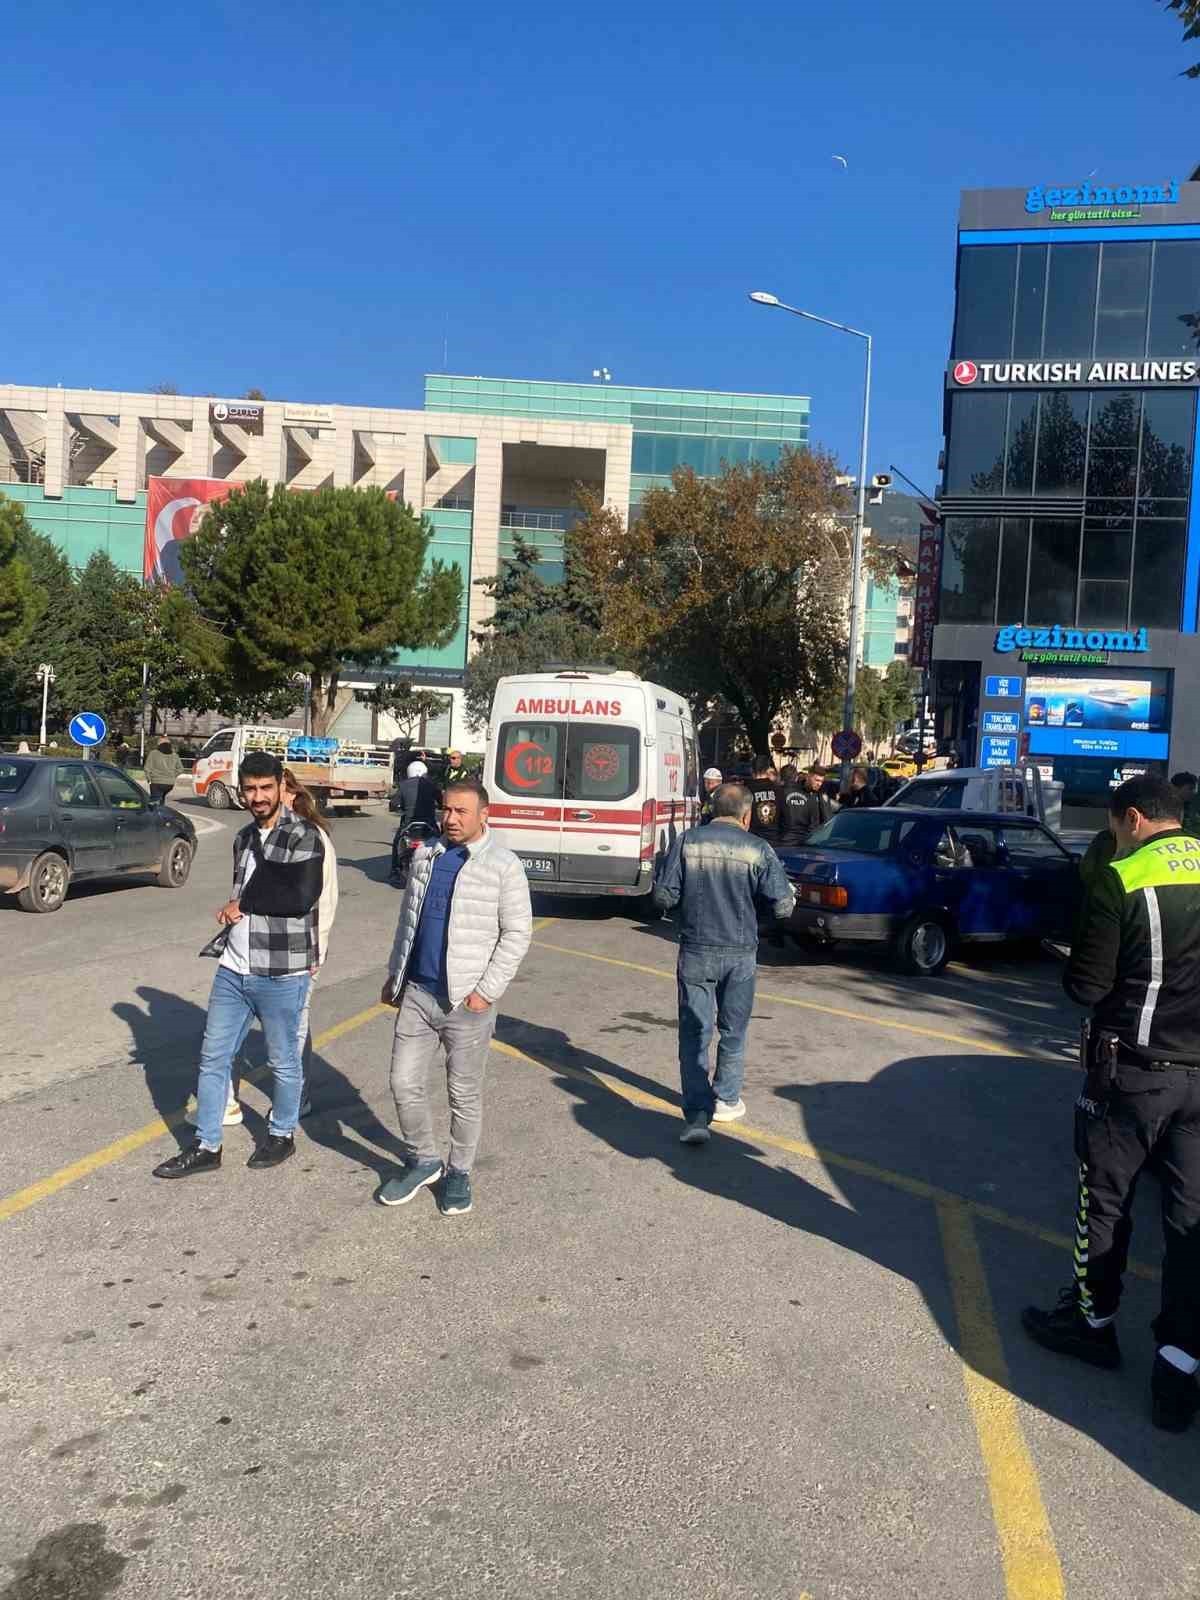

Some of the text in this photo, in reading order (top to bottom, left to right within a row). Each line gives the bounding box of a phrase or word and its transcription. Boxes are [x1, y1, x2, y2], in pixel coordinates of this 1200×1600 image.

[1024, 181, 1180, 213] gezinomi
[980, 361, 1197, 382] TURKISH AIRLINES
[997, 624, 1150, 652] gezinomi
[515, 698, 622, 716] AMBULANS
[526, 754, 553, 774] 112
[535, 859, 551, 870] 512
